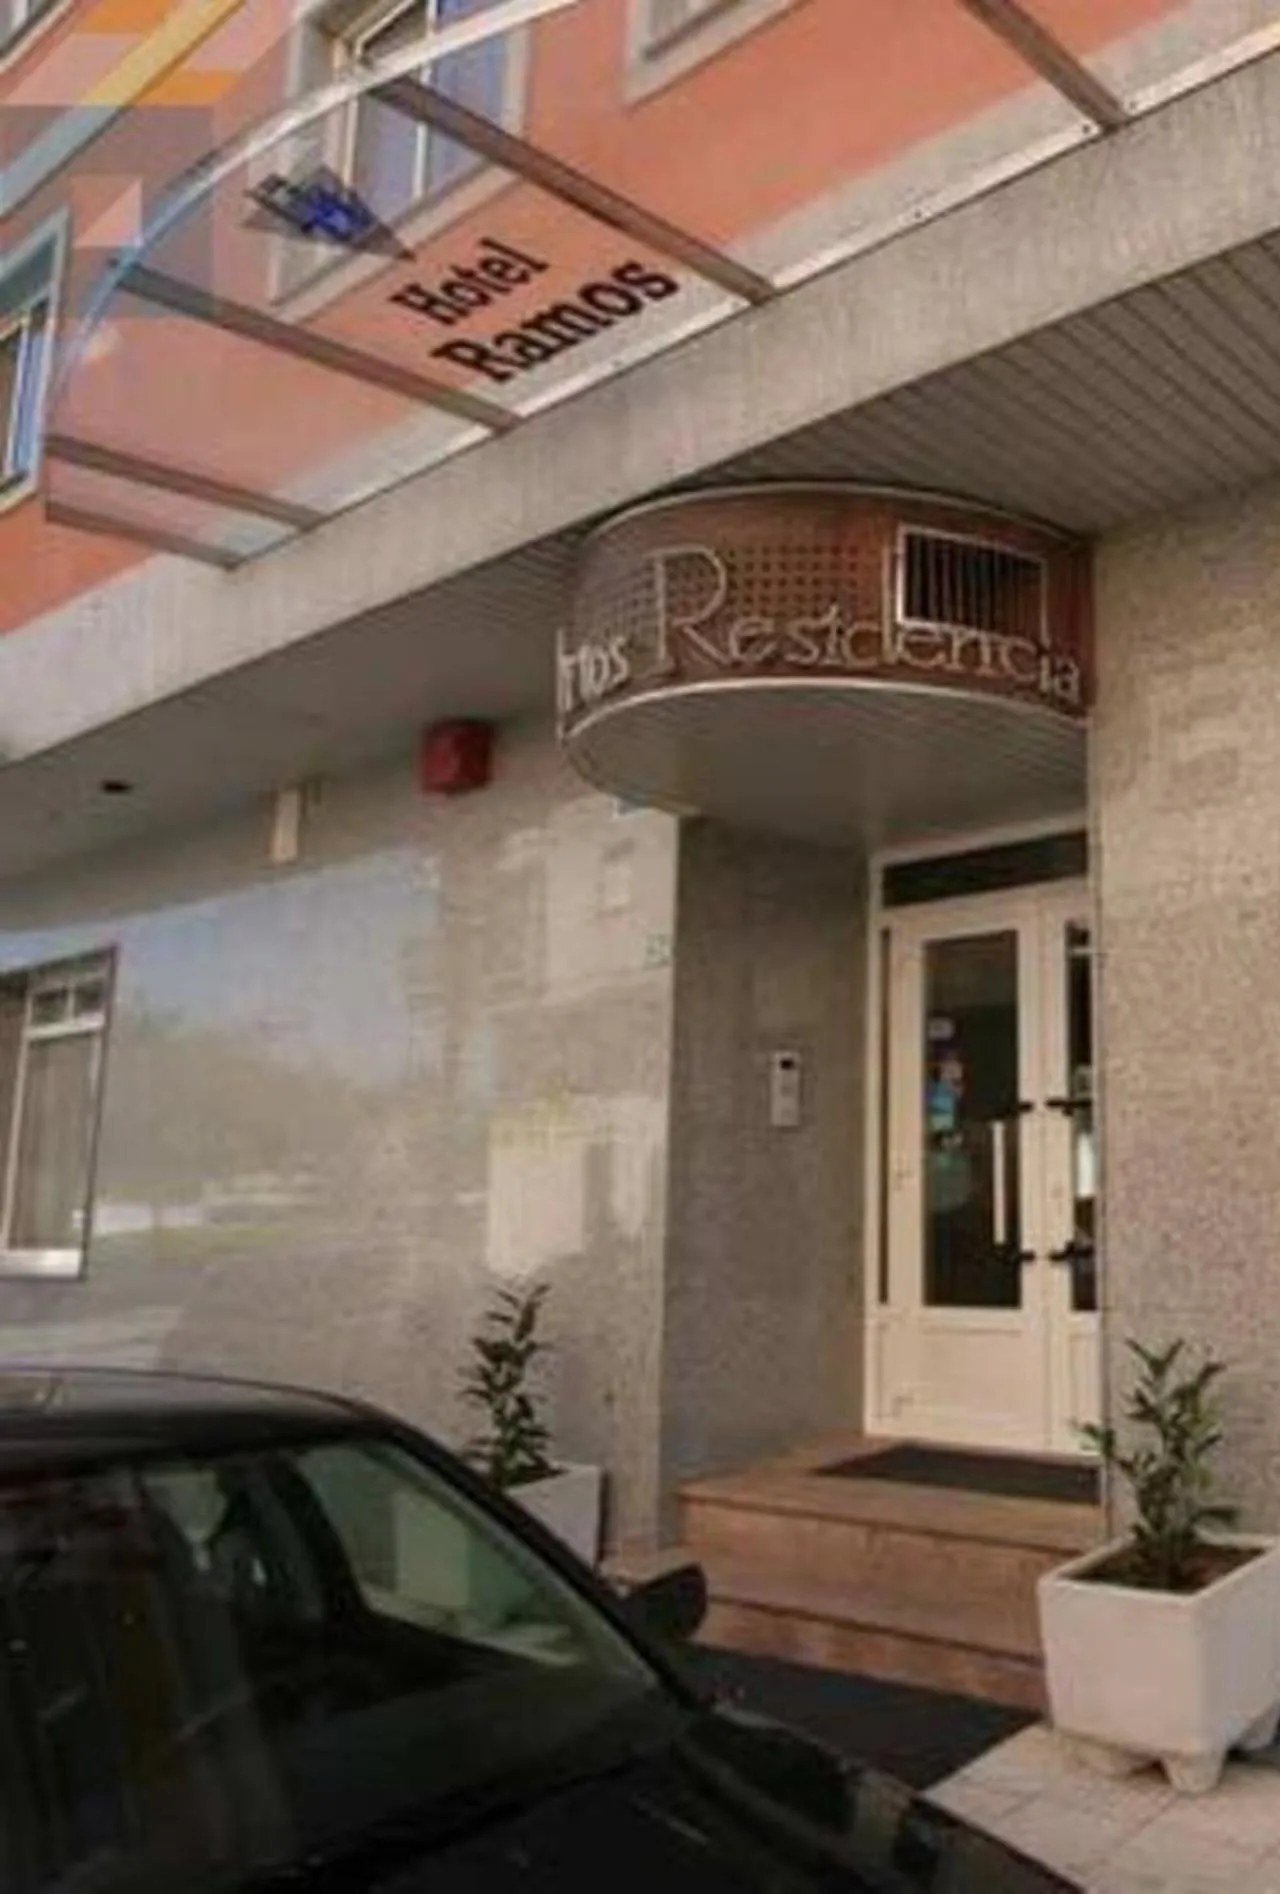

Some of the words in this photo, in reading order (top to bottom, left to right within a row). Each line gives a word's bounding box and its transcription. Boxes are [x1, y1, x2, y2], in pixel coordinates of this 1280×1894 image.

[391, 237, 549, 326] Hotel
[429, 260, 680, 383] Ramos
[640, 540, 1082, 700] Residencia
